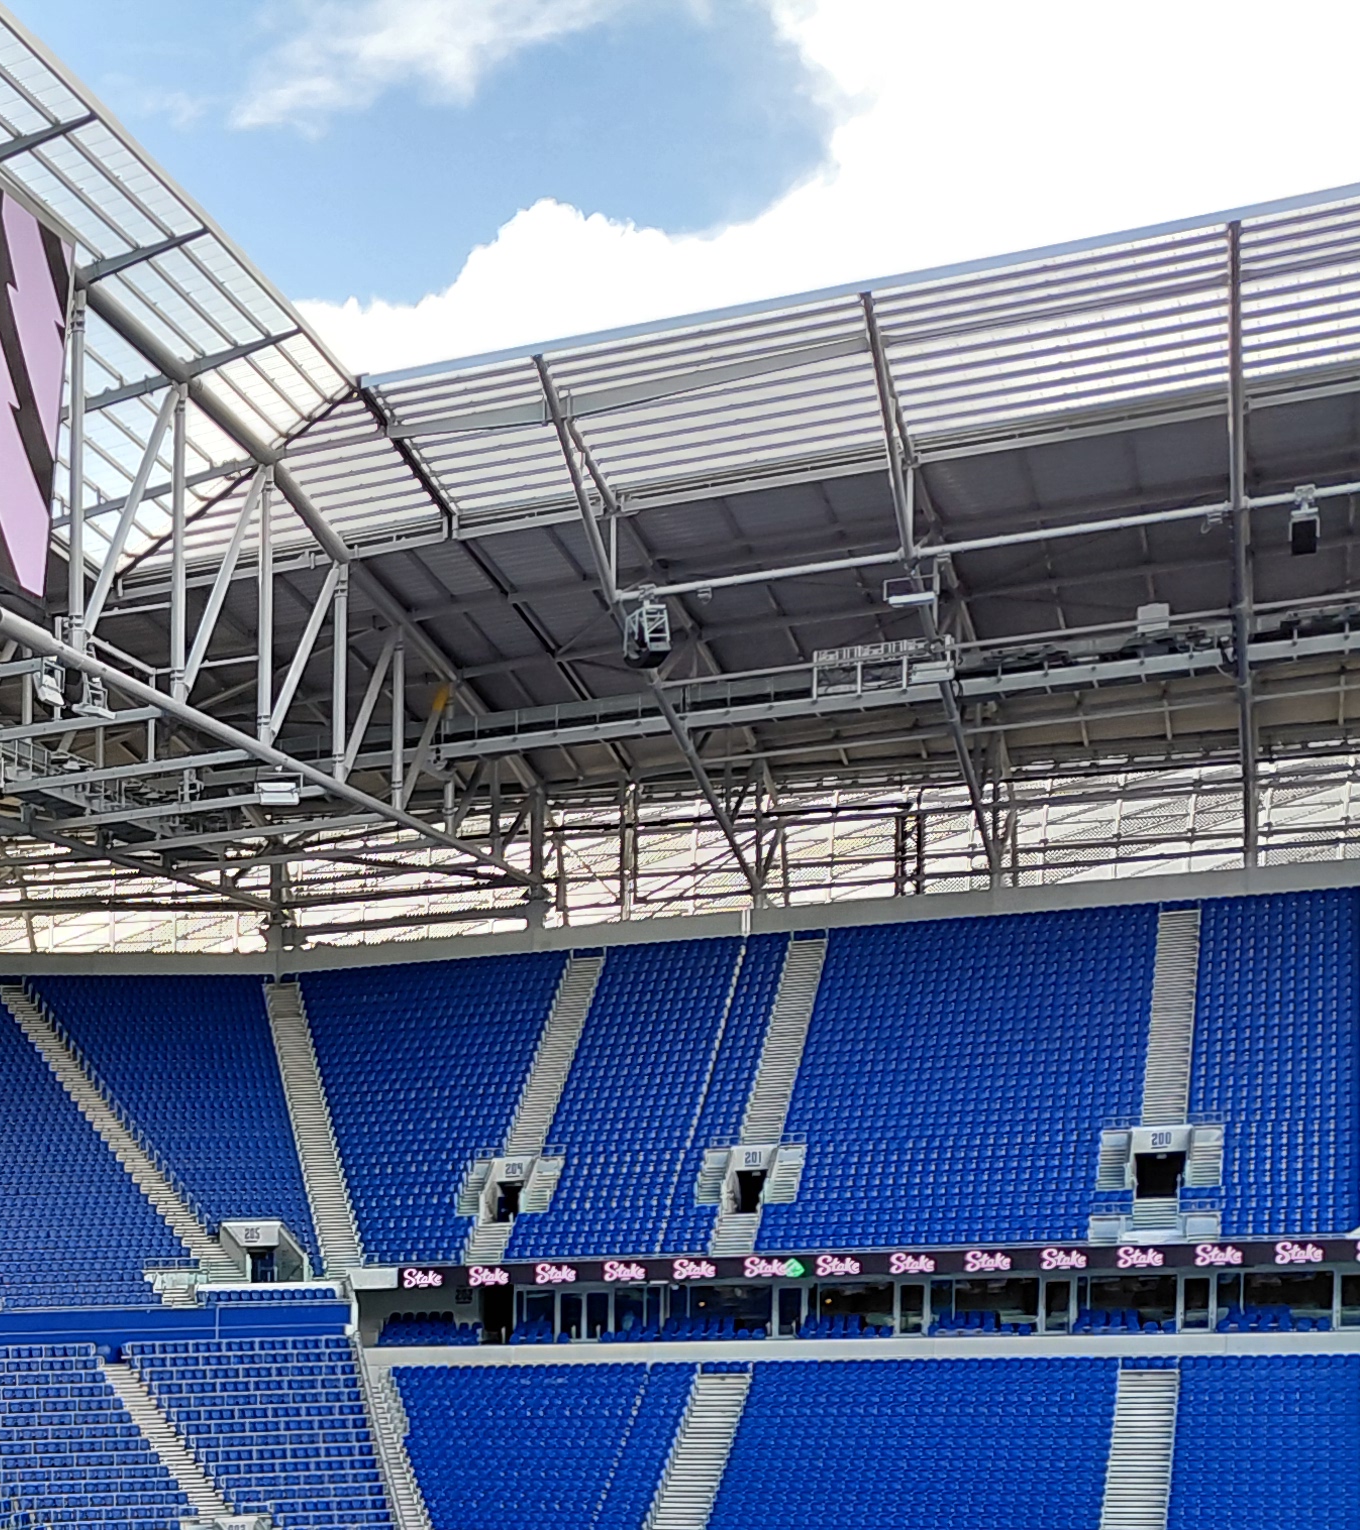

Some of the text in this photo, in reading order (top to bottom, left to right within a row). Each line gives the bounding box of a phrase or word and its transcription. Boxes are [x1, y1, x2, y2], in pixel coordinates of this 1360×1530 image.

[1151, 1132, 1172, 1146] 200
[744, 1151, 762, 1164] 201
[890, 1253, 935, 1274] Stake
[965, 1251, 1011, 1272] Stake
[1042, 1248, 1086, 1270] Stake
[1118, 1246, 1163, 1268] Stake
[1196, 1244, 1242, 1266] Stake
[1275, 1242, 1323, 1264] Stake
[469, 1266, 509, 1286] Stake
[536, 1264, 576, 1284] Stake
[604, 1261, 645, 1282] Stake
[674, 1259, 715, 1280] Stake
[745, 1257, 787, 1278] Stake
[817, 1255, 860, 1276] Stake
[404, 1268, 442, 1288] Stake
